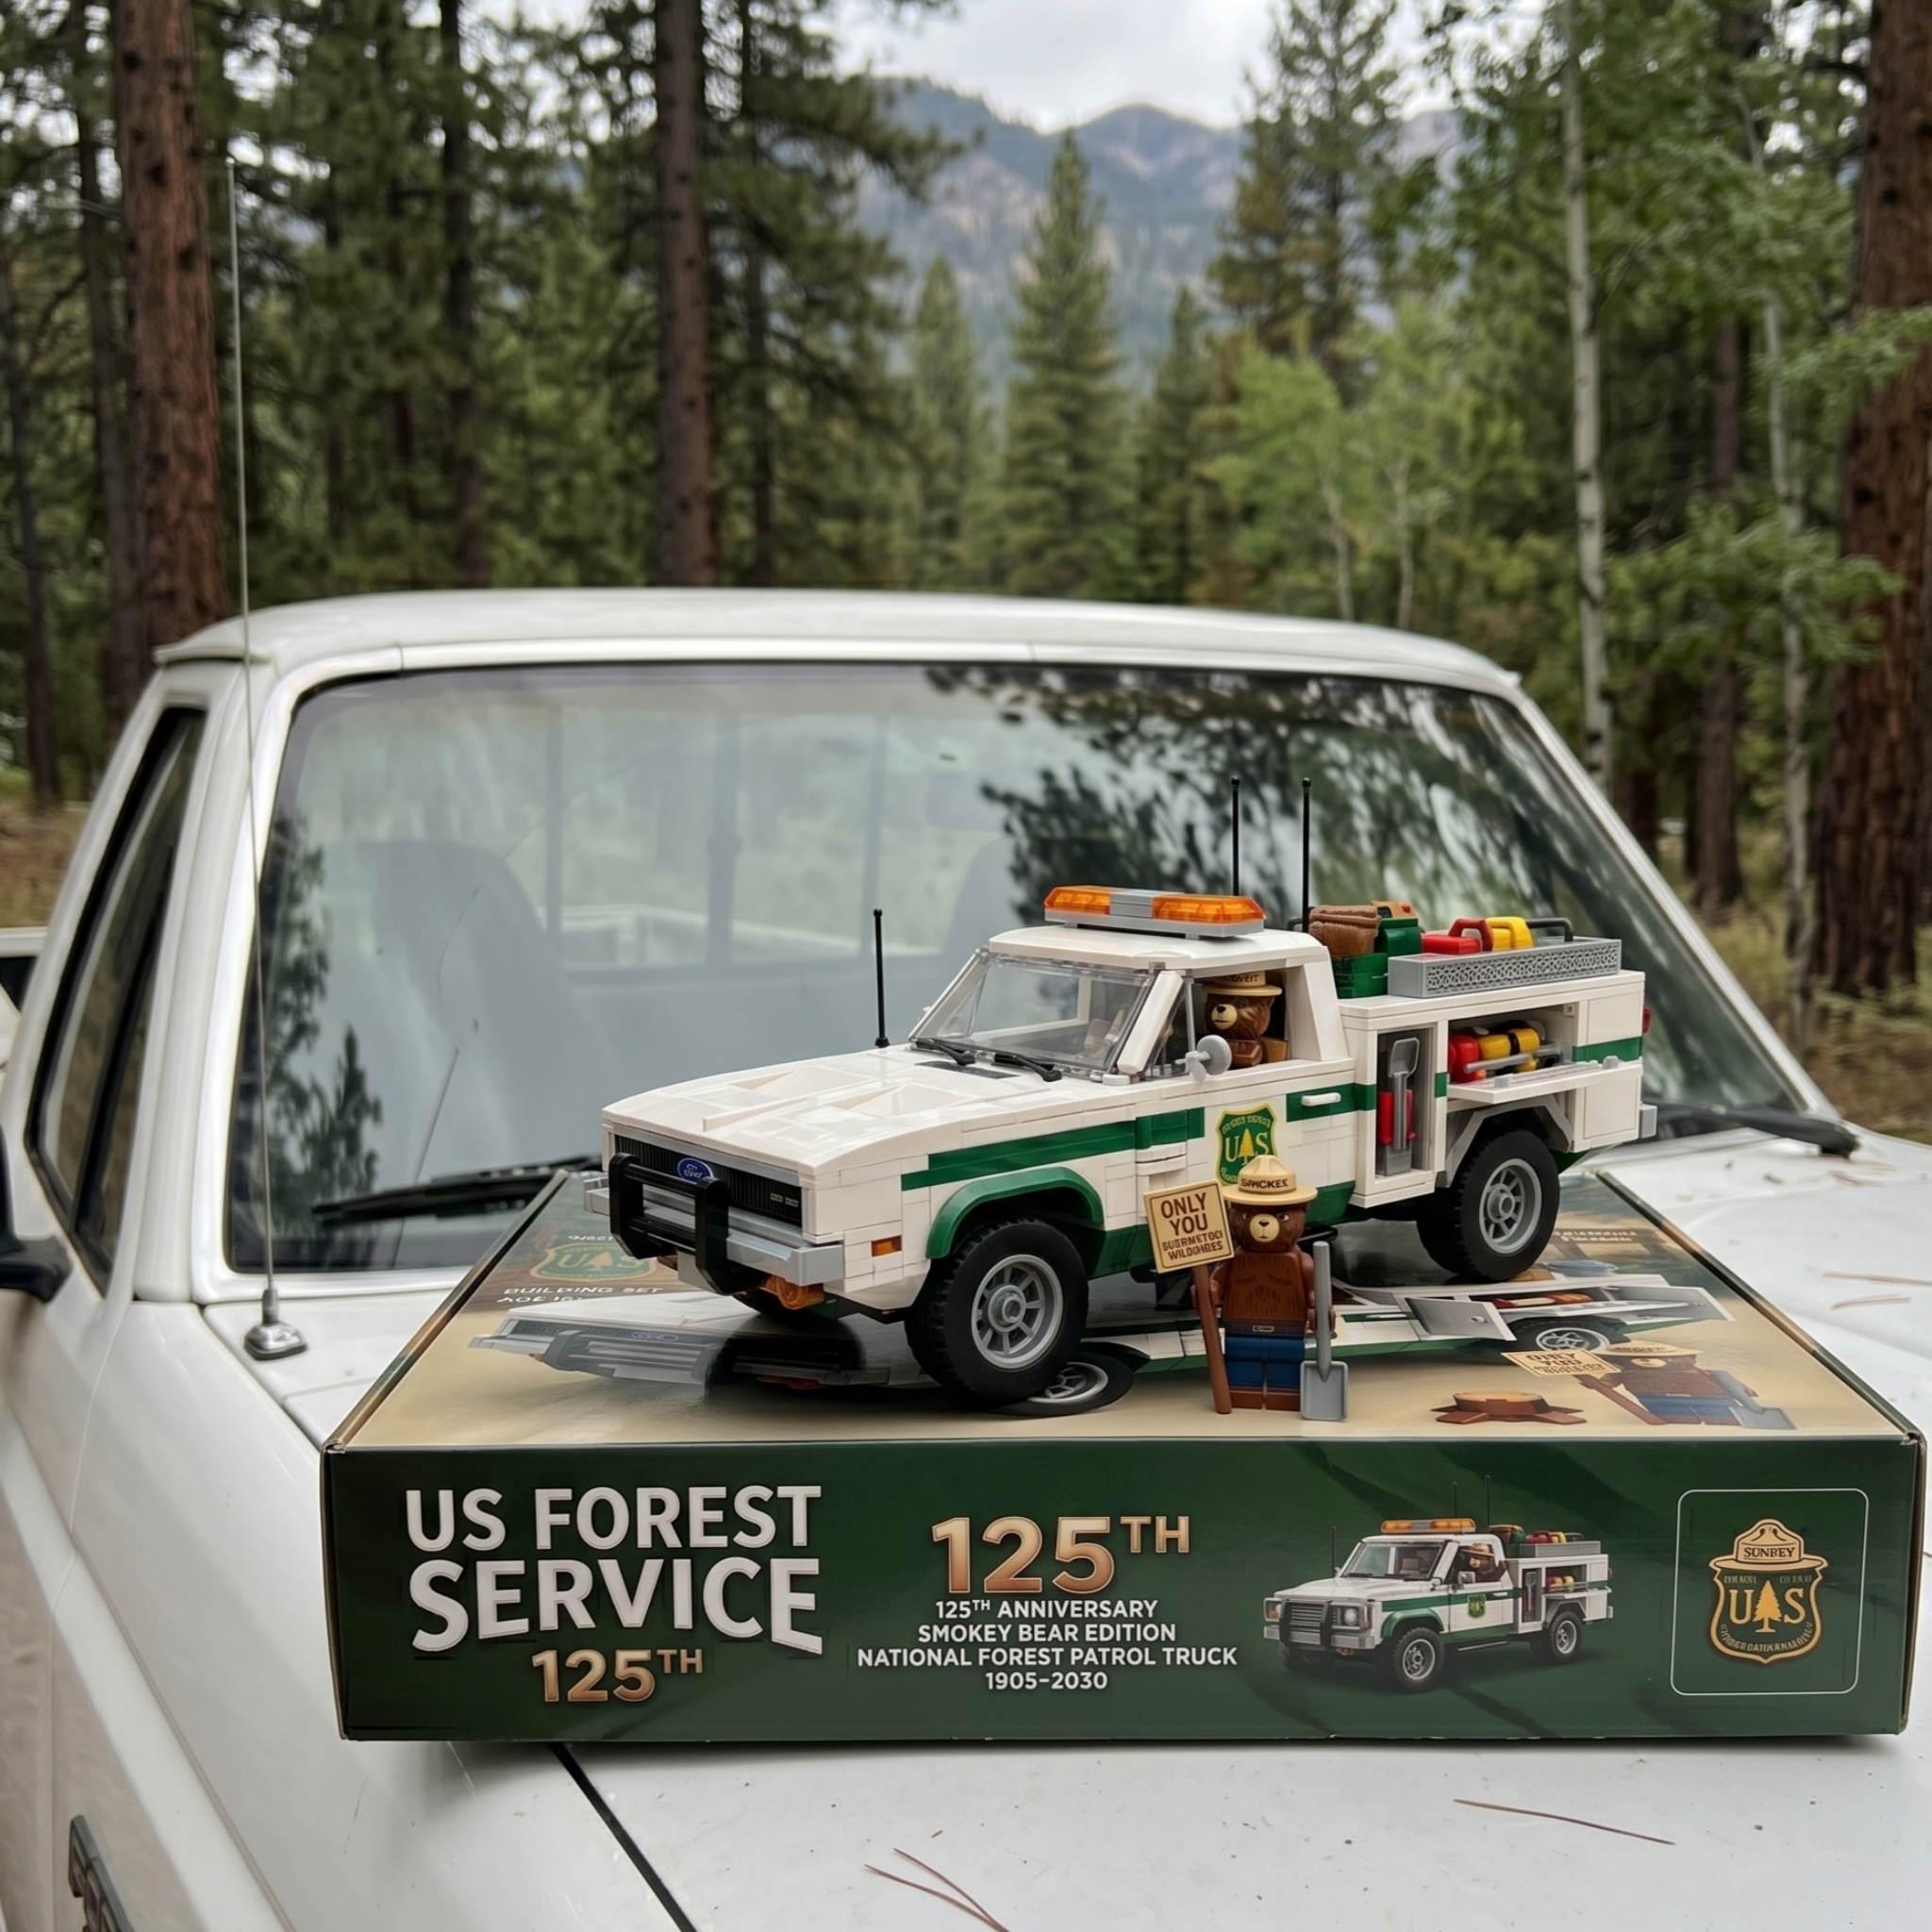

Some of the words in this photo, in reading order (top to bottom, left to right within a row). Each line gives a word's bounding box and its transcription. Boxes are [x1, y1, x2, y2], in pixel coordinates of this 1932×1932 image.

[1160, 1191, 1207, 1219] ONLY
[1169, 1212, 1208, 1237] YOU
[406, 1488, 507, 1552] US
[535, 1485, 823, 1550] FOREST
[932, 1516, 1190, 1594] 125TH
[408, 1557, 824, 1655] SERVICE
[936, 1599, 991, 1619] 125TH
[997, 1599, 1158, 1619] ANNIVERSARY
[1728, 1589, 1755, 1624] U
[1783, 1588, 1807, 1624] S
[918, 1624, 1012, 1643] SMOKEY
[1018, 1624, 1079, 1642] BEAR
[1085, 1623, 1176, 1641] EDITION
[858, 1648, 973, 1667] NATIONAL
[978, 1647, 1065, 1667] FOREST
[1071, 1647, 1157, 1666] PATROL
[1162, 1647, 1239, 1665] TRUCK
[531, 1648, 703, 1703] 125TH
